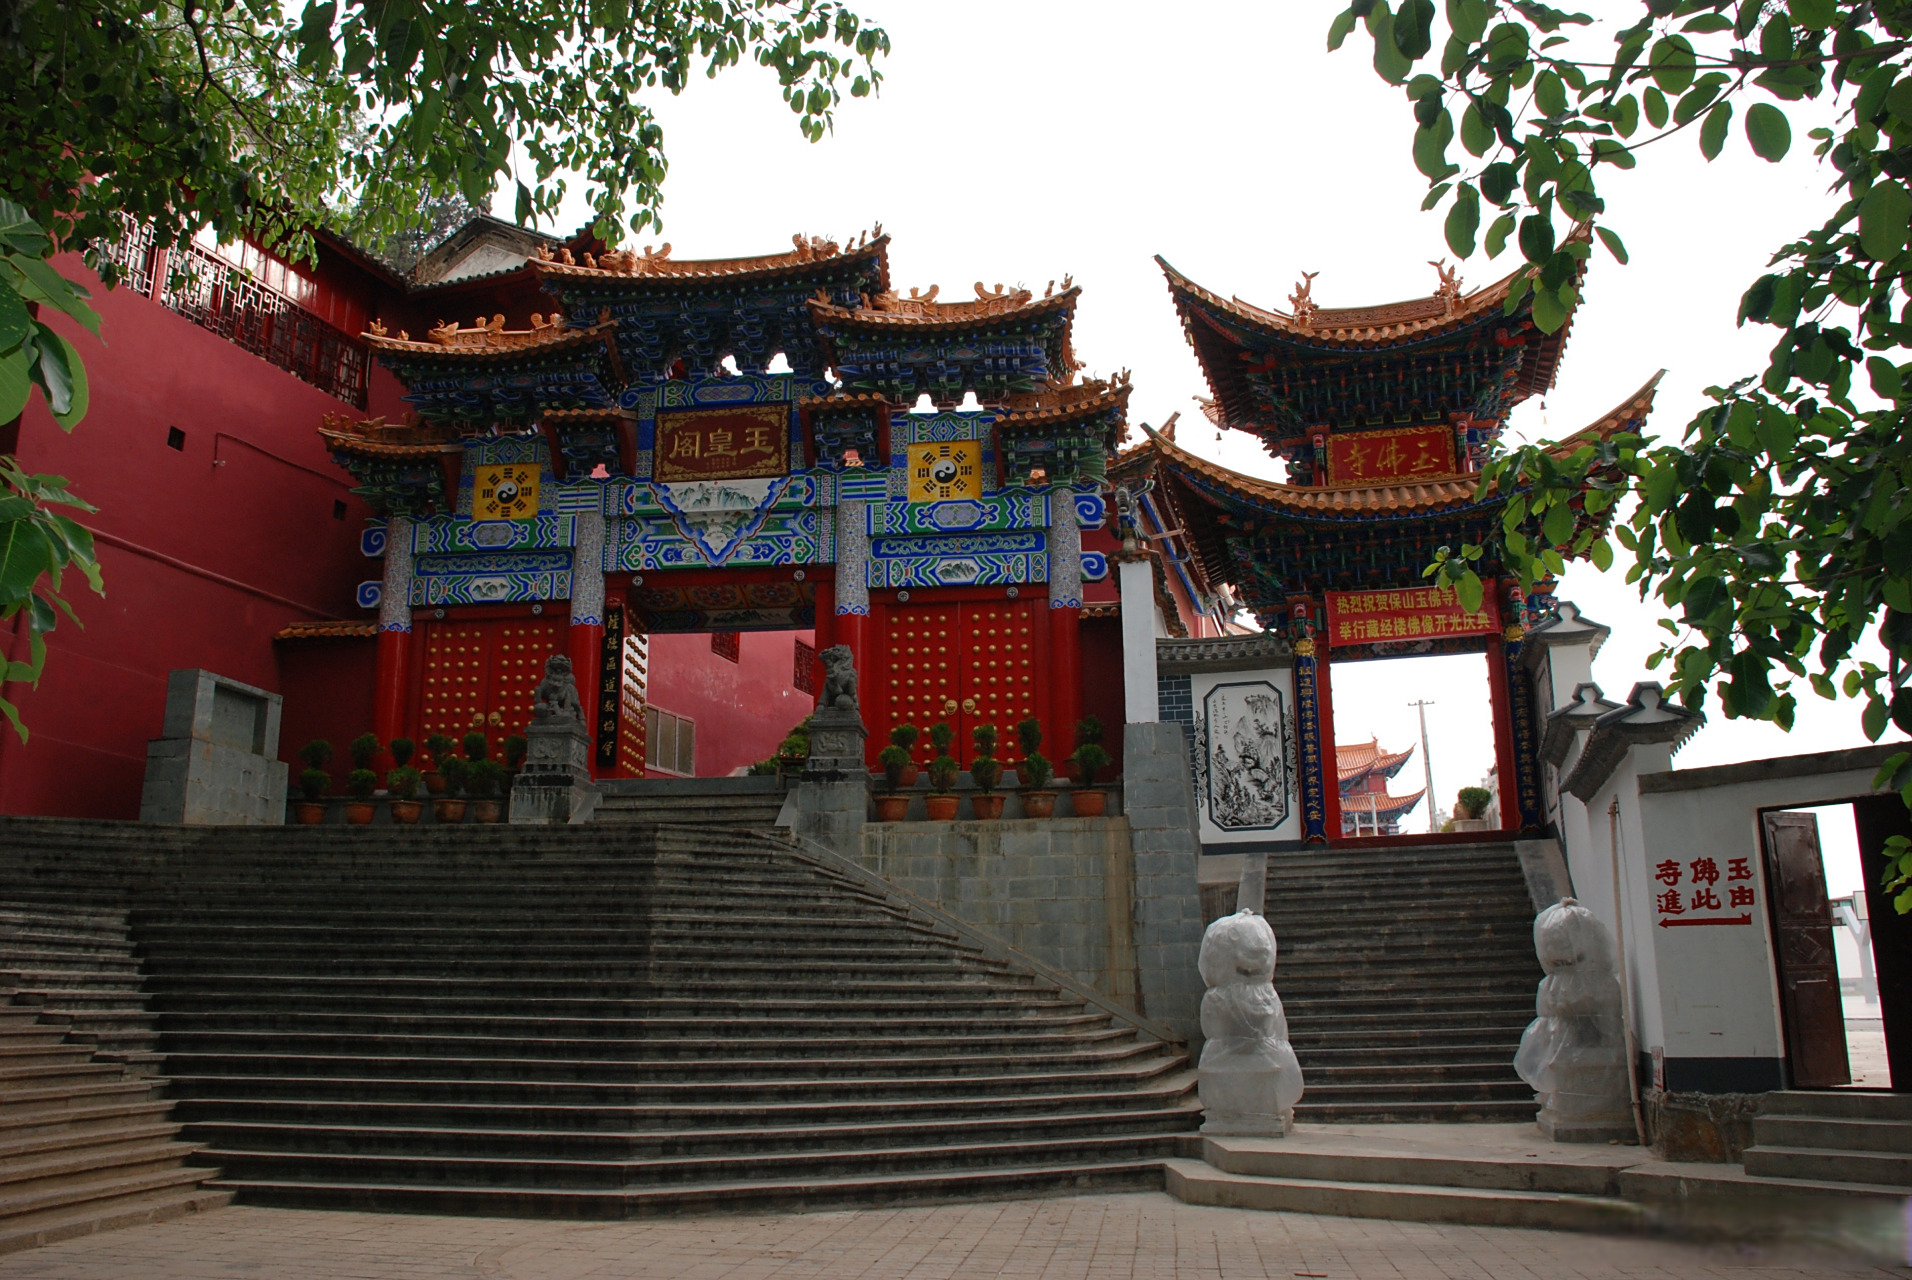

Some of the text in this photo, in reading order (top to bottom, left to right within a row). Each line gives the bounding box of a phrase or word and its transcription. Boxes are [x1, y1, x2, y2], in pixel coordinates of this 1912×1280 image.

[668, 427, 775, 459] 玉皇阁
[1343, 437, 1440, 476] 玉佛寺
[1336, 589, 1462, 615] 热烈祝贺保山玉佛寺
[1339, 610, 1491, 640] 举行藏经楼佛像开光庆典
[1655, 857, 1754, 887] 玉佛寺
[1656, 885, 1755, 915] 由此進
